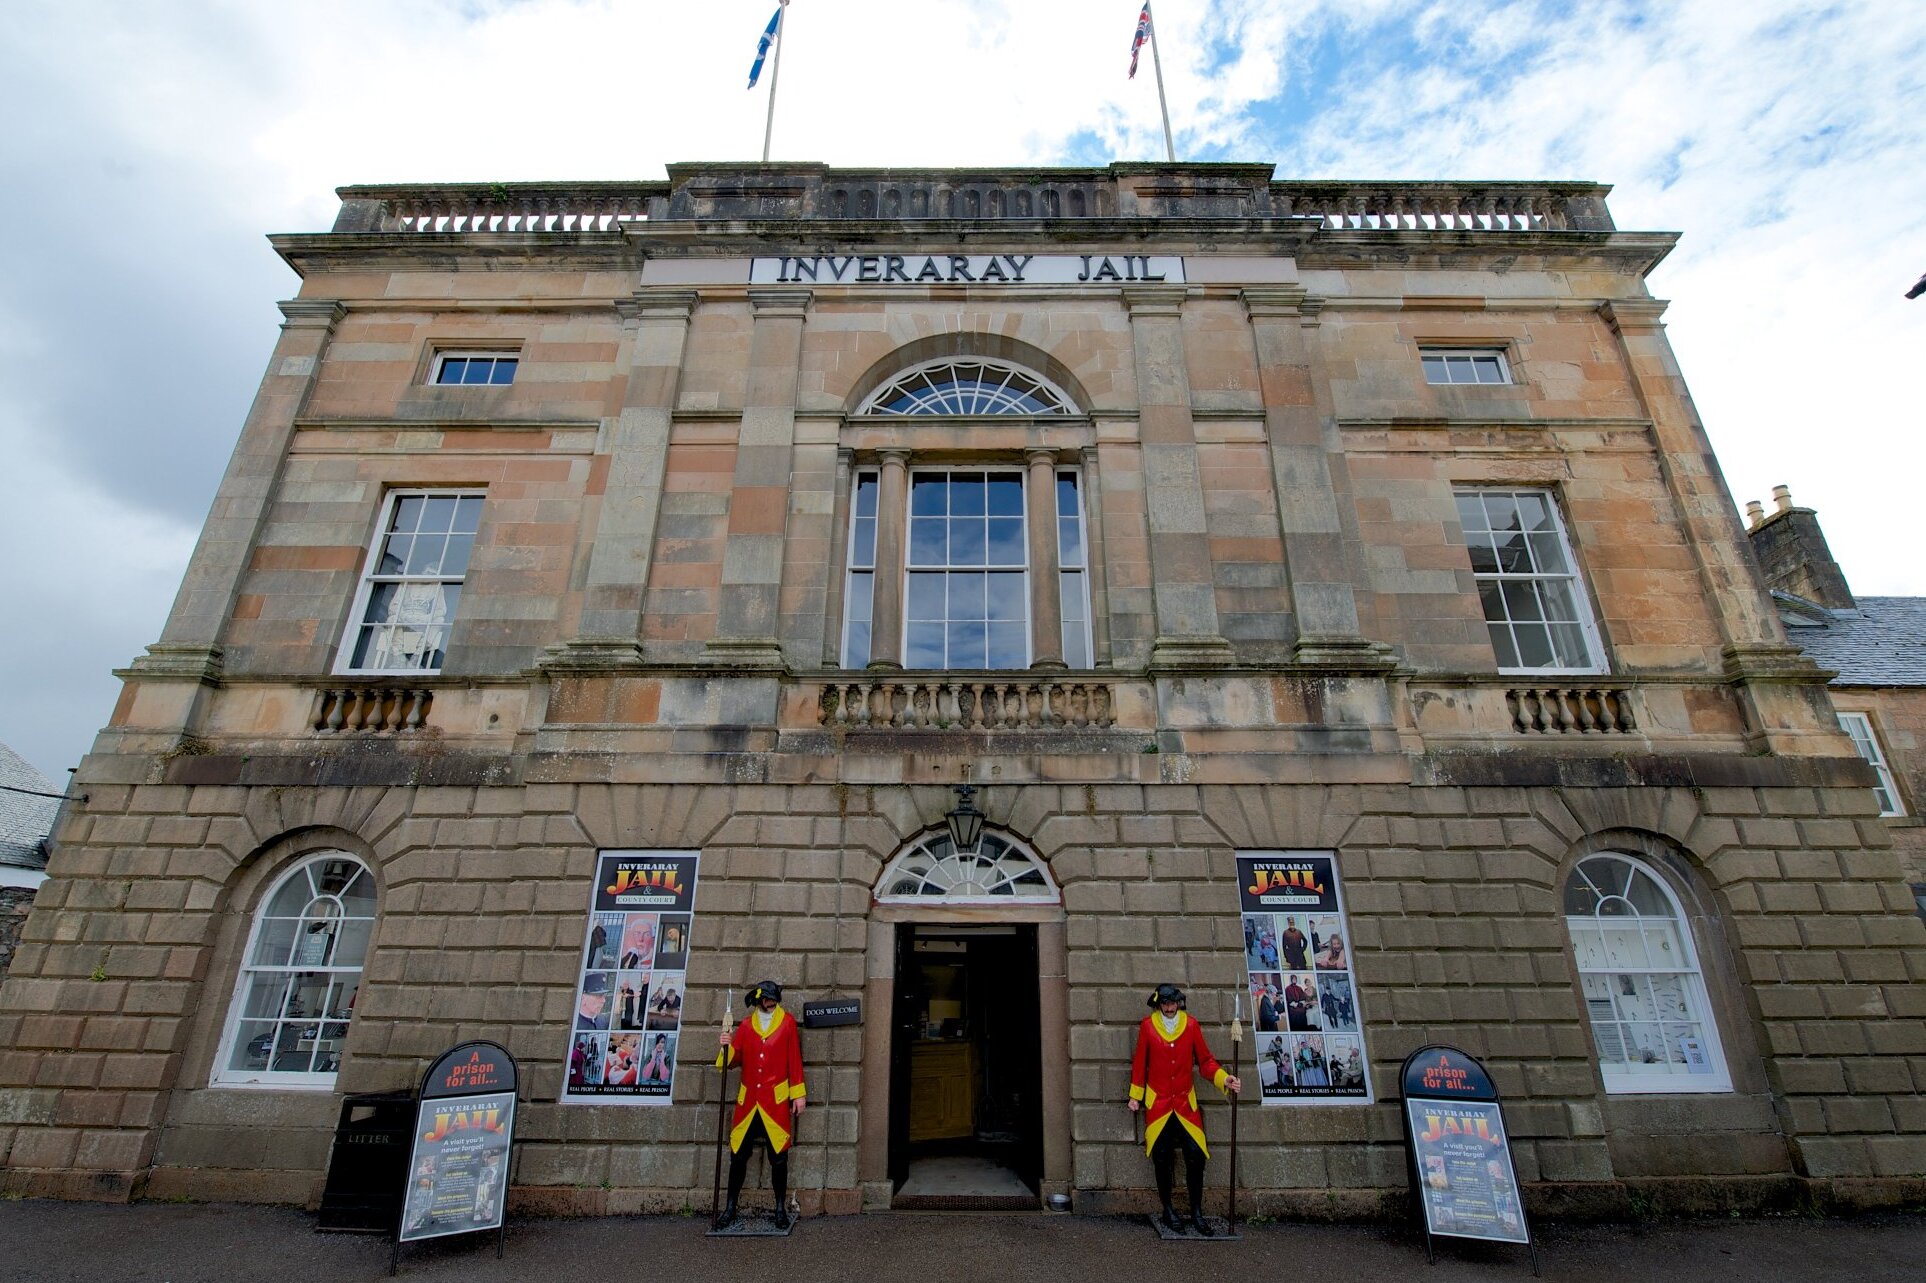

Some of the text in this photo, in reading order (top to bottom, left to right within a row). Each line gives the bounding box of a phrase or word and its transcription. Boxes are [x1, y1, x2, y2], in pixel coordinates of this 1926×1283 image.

[776, 255, 1167, 282] INVERARAY JAIL
[606, 870, 683, 895] JAIL
[1248, 870, 1325, 895] JAIL
[643, 886, 653, 895] &
[1285, 886, 1294, 895] &
[826, 1006, 858, 1015] WELCOME
[471, 1051, 480, 1063] A
[1440, 1055, 1448, 1066] A
[452, 1062, 495, 1076] prison
[1426, 1066, 1467, 1080] prison
[445, 1076, 465, 1088] for
[1423, 1077, 1442, 1089] for
[435, 1102, 499, 1114] INVERARAY
[1424, 1108, 1486, 1119] INVERARAY
[424, 1109, 505, 1142] JAIL
[1421, 1115, 1500, 1146] JAIL
[348, 1135, 389, 1143] LITTER
